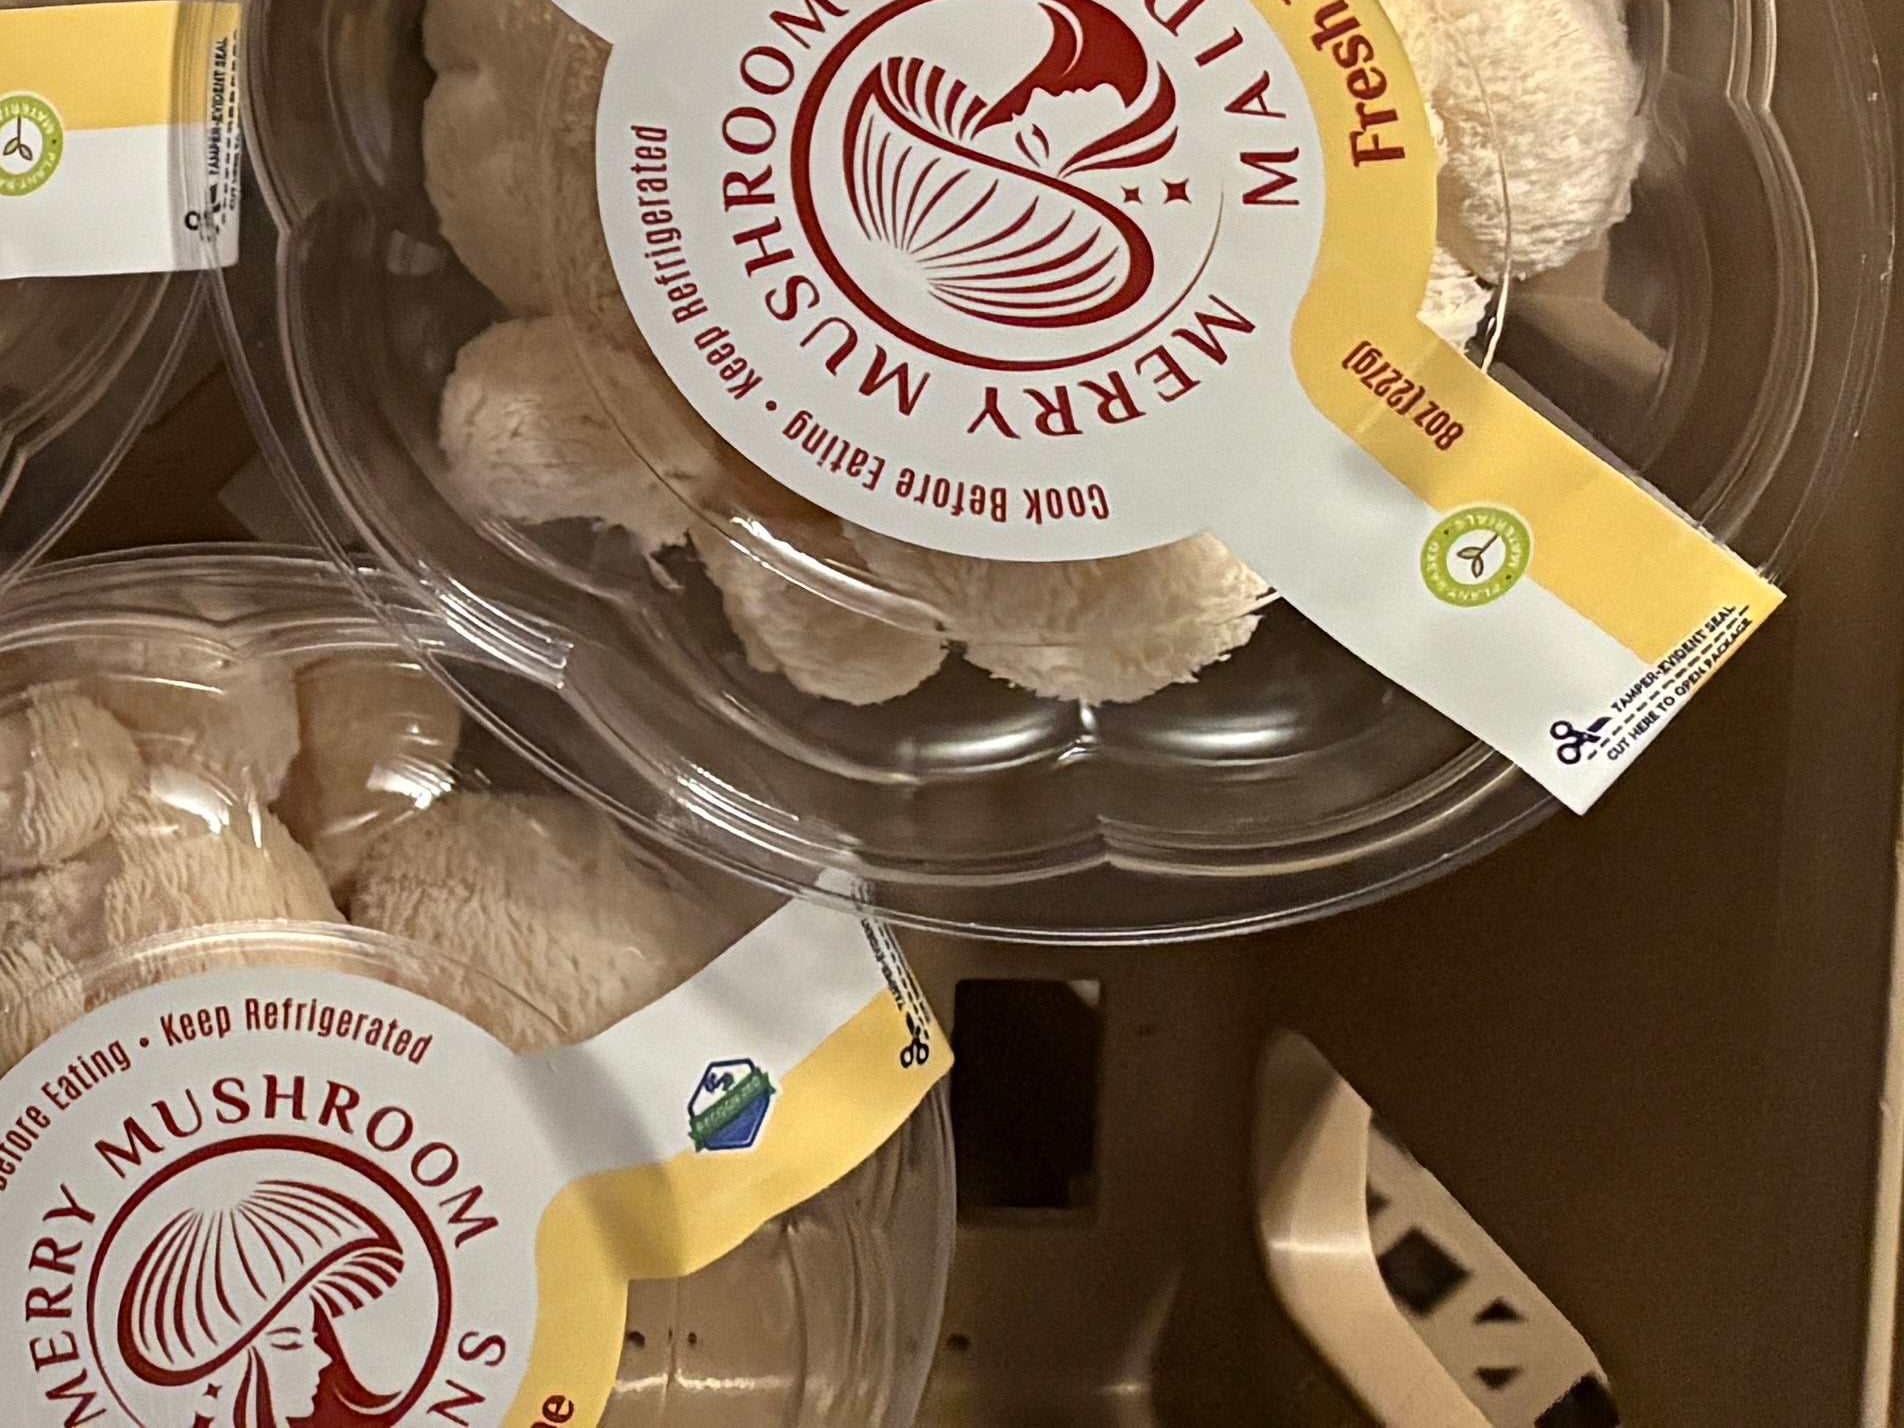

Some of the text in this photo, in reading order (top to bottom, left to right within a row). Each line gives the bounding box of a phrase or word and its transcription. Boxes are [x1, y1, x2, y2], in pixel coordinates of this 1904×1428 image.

[632, 125, 1109, 524] Cook Before Eating Keep Refrigerated
[969, 298, 1254, 437] MERRY
[1341, 340, 1464, 451] 8oz (227g)
[1611, 606, 1736, 713] TAMPER-EVIDENT SEAL
[1607, 736, 1630, 760] CUT
[1628, 711, 1660, 741] HERE
[1656, 697, 1675, 712] TO
[42, 1041, 131, 1110] Eating
[161, 1006, 232, 1046] Keep
[245, 998, 432, 1064] Refrigerated
[26, 1074, 498, 1428] MERRY MUSHROOM
